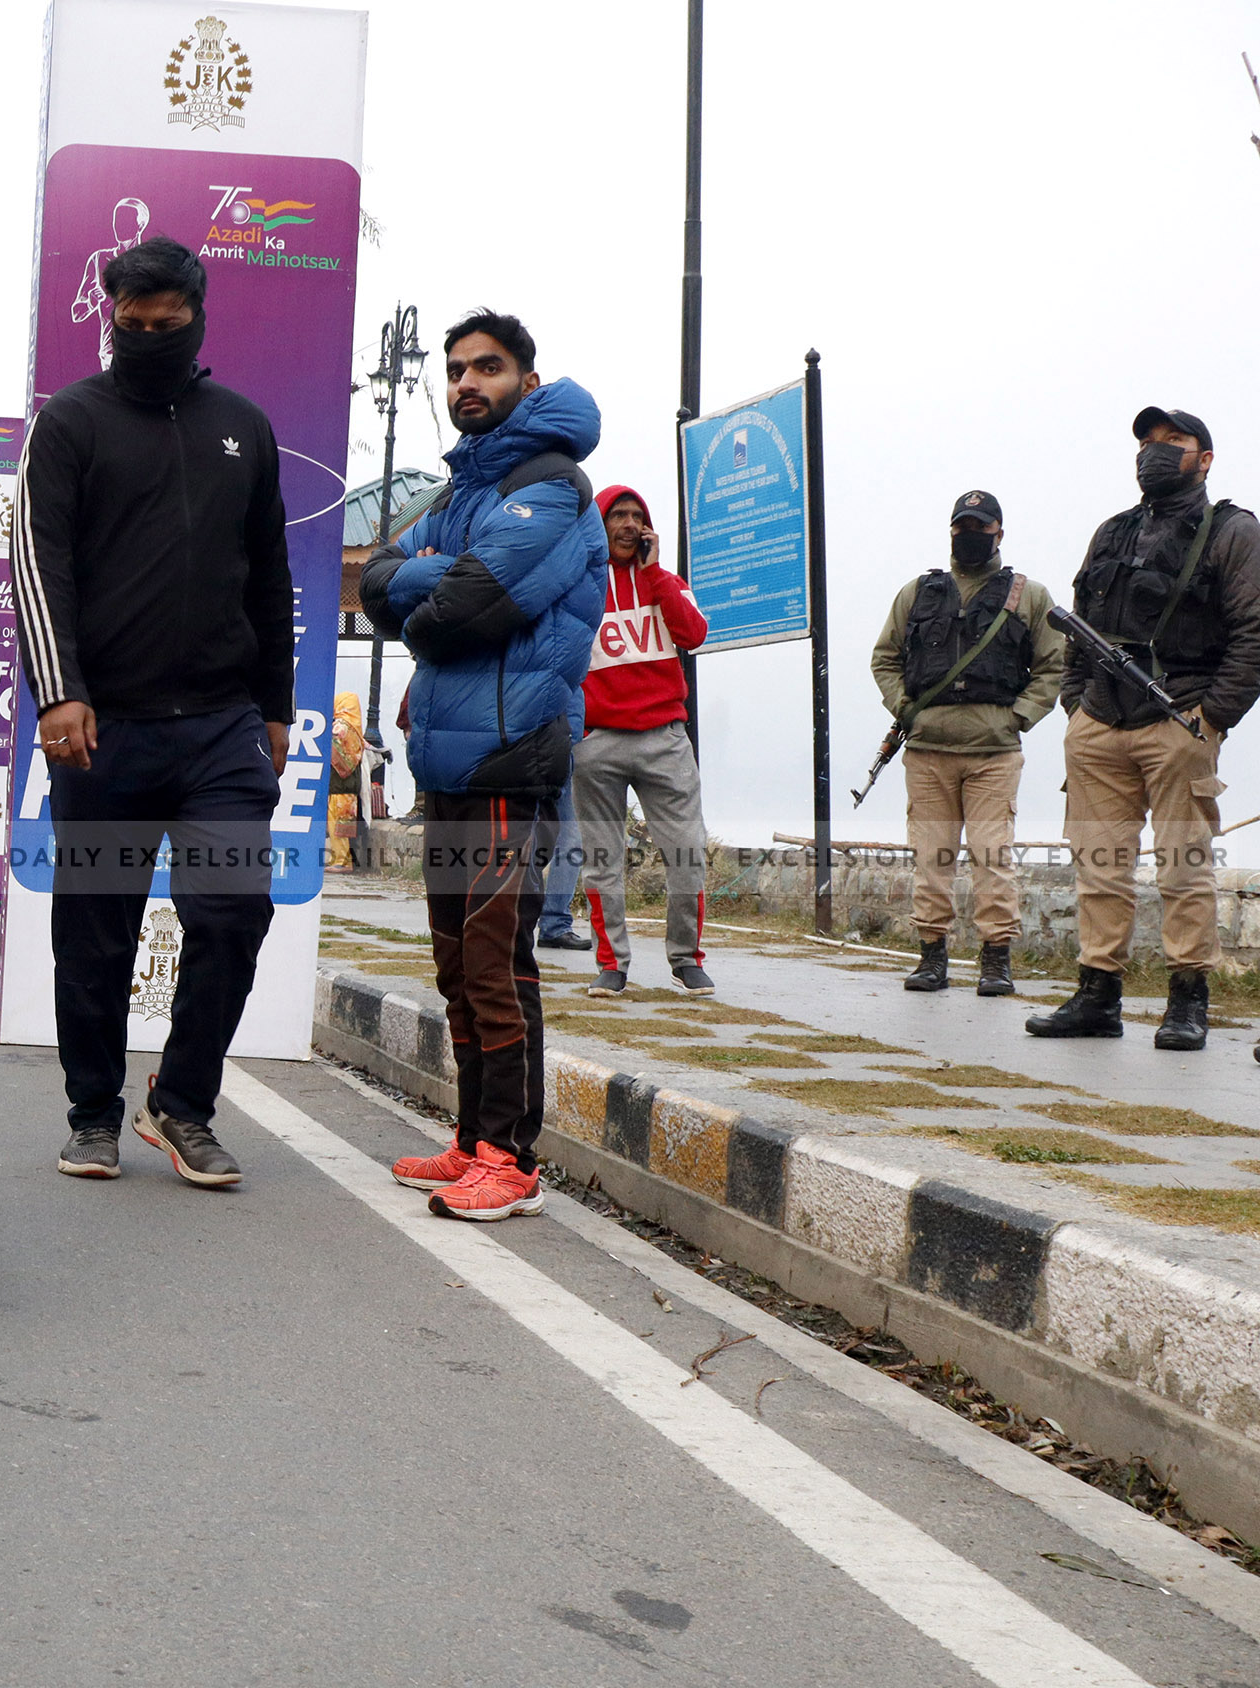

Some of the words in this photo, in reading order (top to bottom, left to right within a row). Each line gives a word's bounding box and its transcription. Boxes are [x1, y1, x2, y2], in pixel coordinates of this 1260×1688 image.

[206, 225, 262, 244] Azadi
[265, 236, 285, 250] Ka
[199, 244, 245, 260] Amrit
[247, 250, 341, 271] Mahotsav
[142, 994, 173, 1003] POLIC
